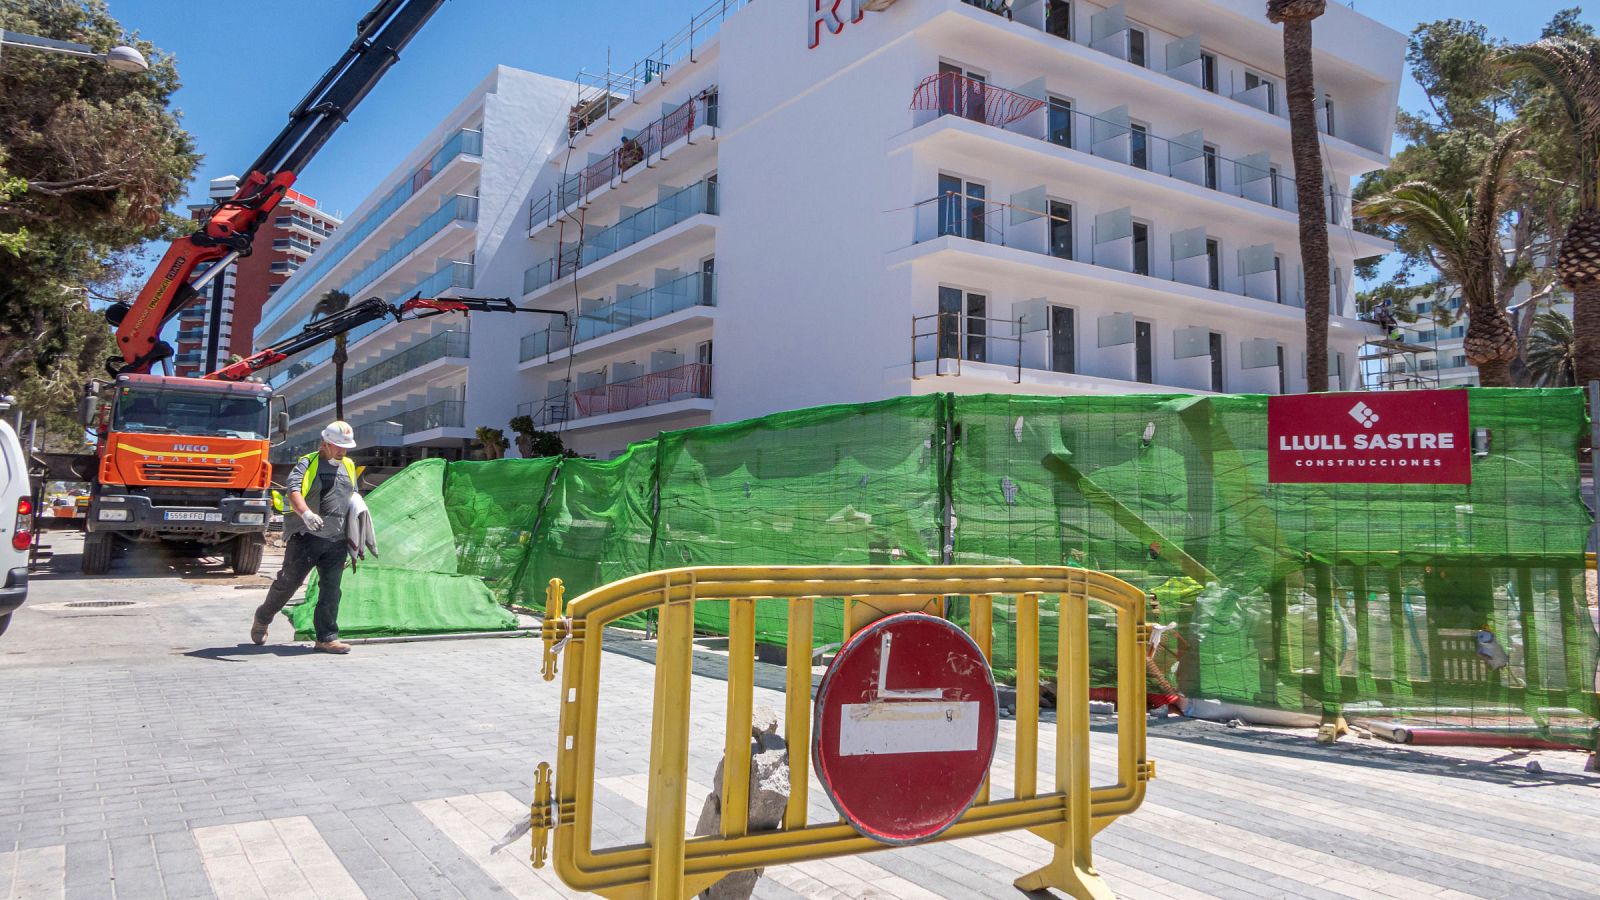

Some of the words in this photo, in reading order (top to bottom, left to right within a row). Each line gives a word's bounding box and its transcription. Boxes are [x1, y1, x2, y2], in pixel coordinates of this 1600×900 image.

[1279, 434, 1347, 451] LLULL
[1353, 432, 1455, 450] SASTRE
[173, 444, 209, 453] IVECO
[143, 455, 236, 464] TRAKKER
[1295, 458, 1442, 467] CONSTRUCCIONES
